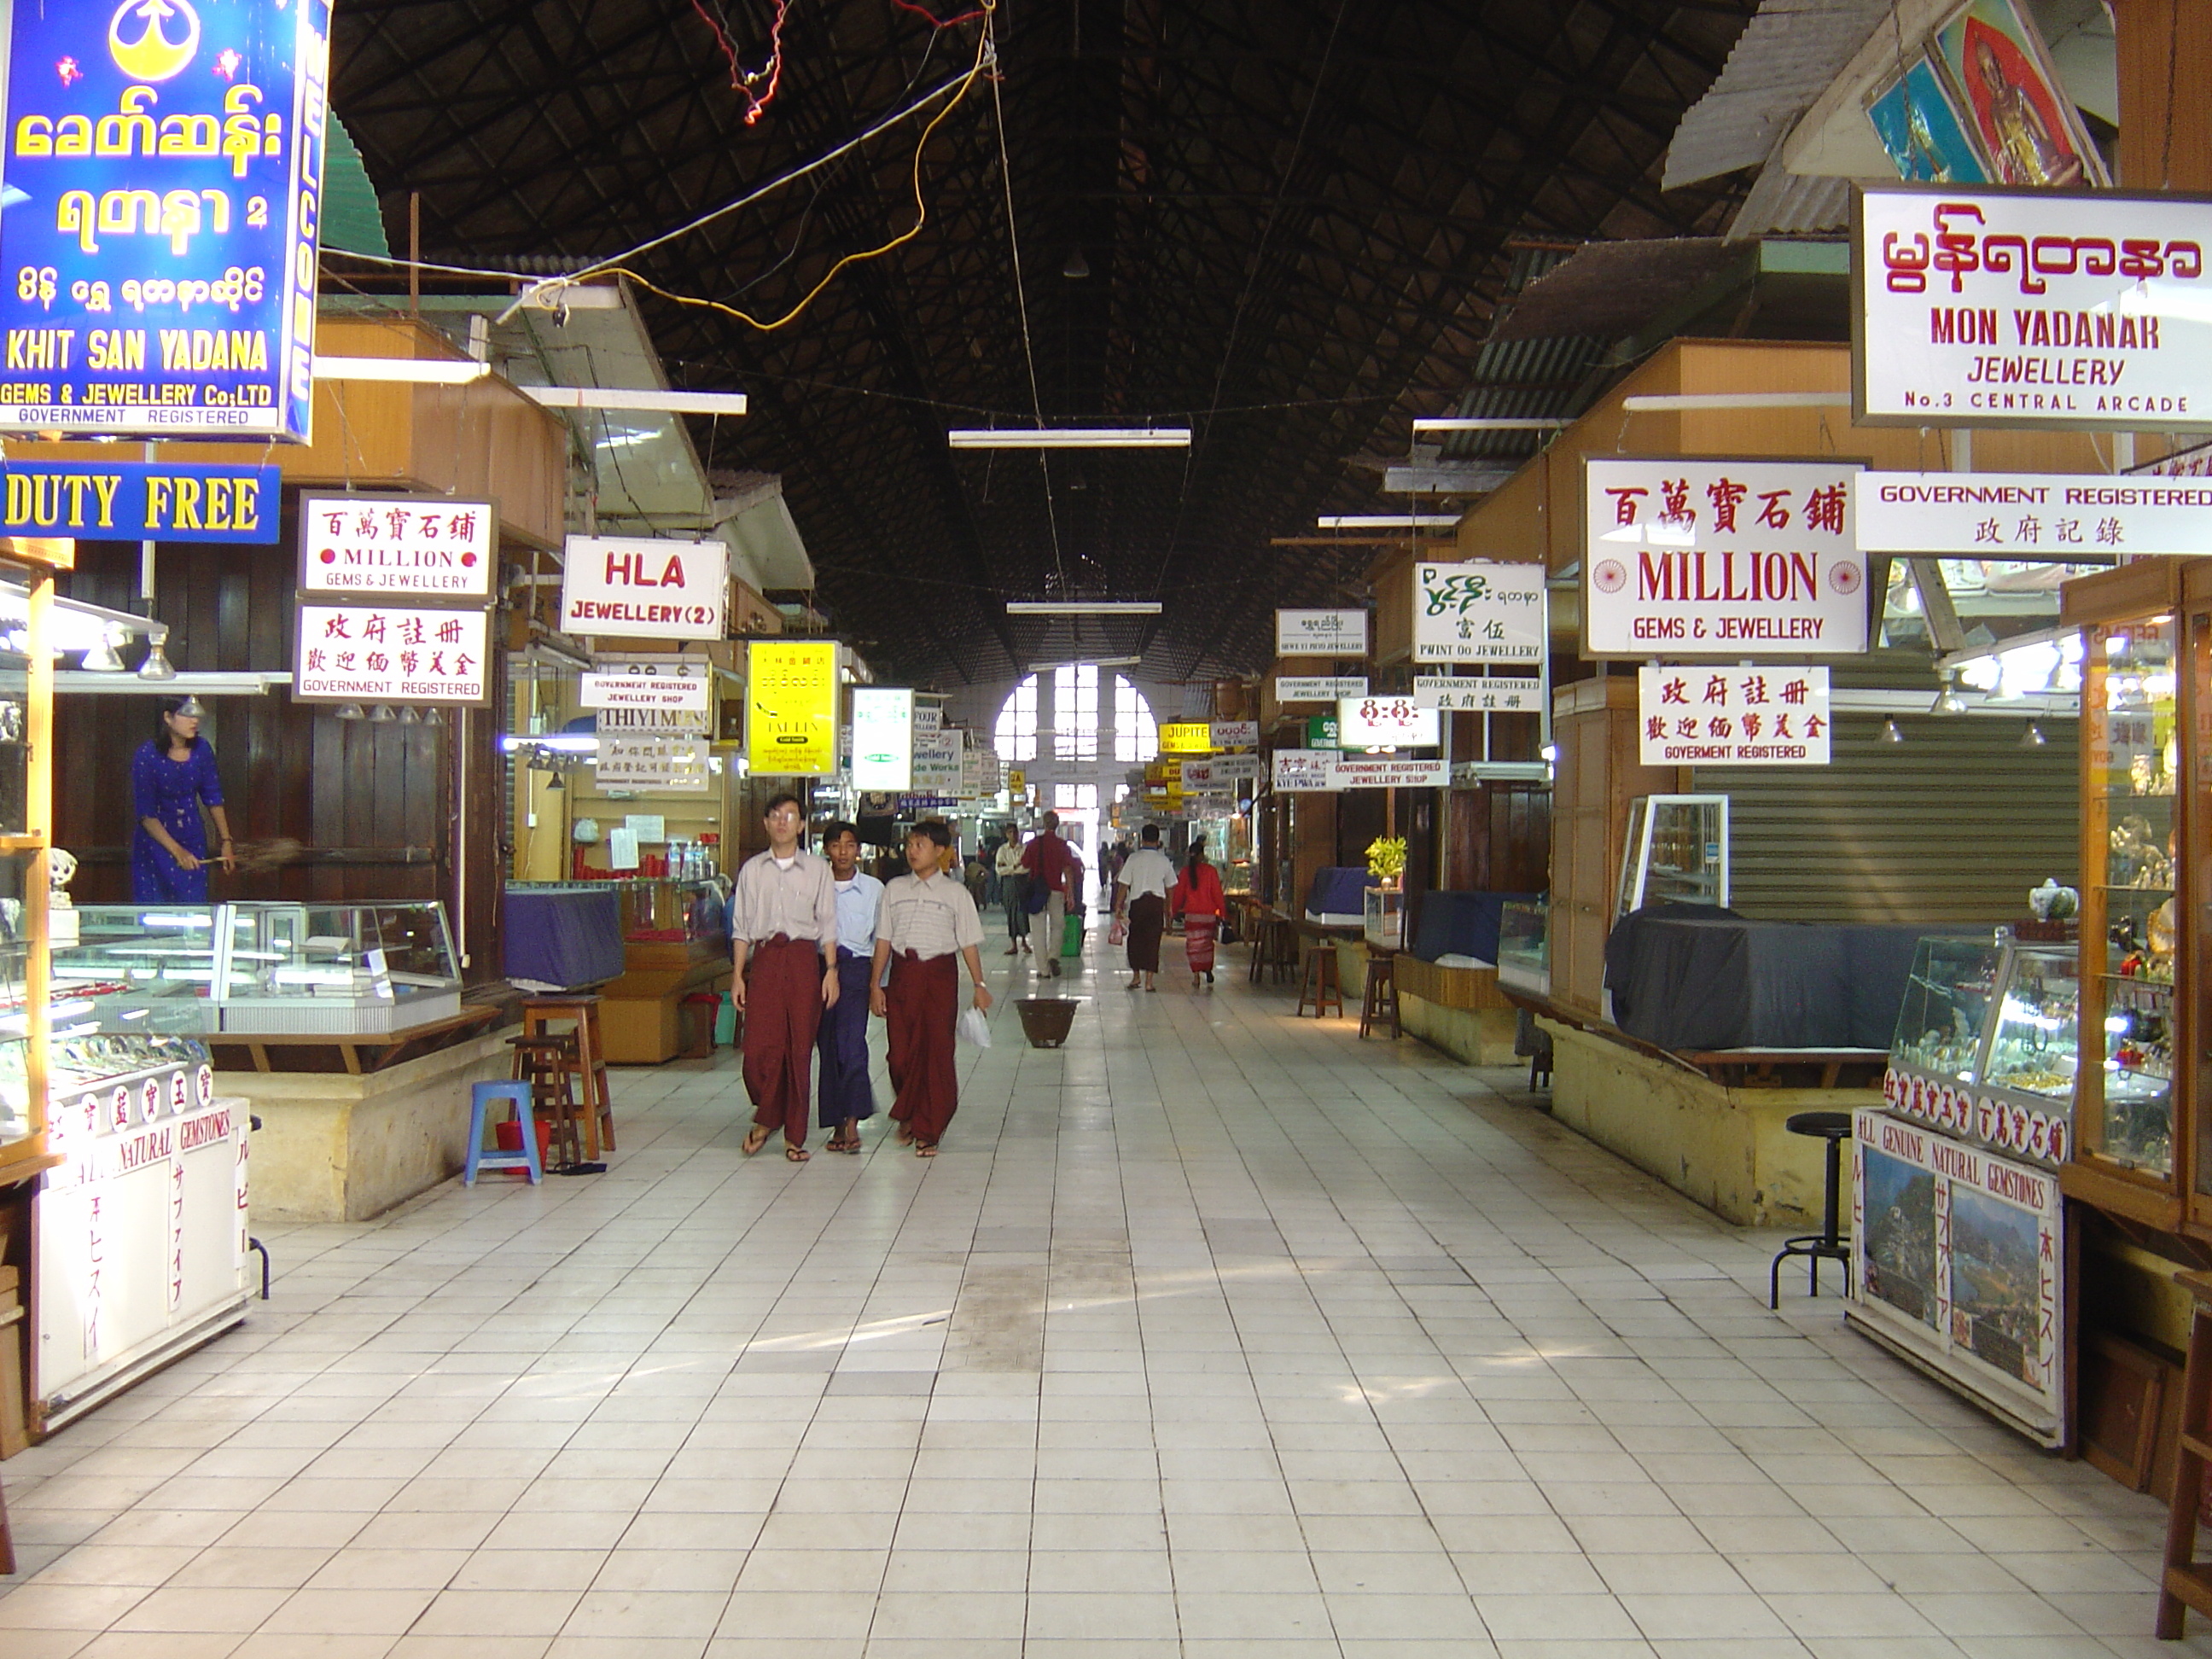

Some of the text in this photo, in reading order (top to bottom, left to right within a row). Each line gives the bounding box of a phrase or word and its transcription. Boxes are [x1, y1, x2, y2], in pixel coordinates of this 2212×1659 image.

[290, 22, 328, 403] WELCOME
[1930, 307, 1999, 346] MON
[7, 329, 268, 371] KHIT SAN YADANA
[1967, 355, 2126, 386] JEWELLERY
[0, 384, 52, 405] GEMS
[61, 384, 73, 405] &
[82, 384, 196, 406] JEWELLERY
[1904, 390, 2188, 413] No.3 CENTRAL ARCADE
[18, 409, 249, 425] GOVERNMENT REGISTERED
[3, 474, 259, 530] DUTY FREE
[1880, 485, 2212, 507] GOVERNMENT REGISTERED
[1974, 514, 2125, 547] 政府記錄
[343, 548, 454, 568] MILLION
[604, 550, 685, 588] HLA
[326, 573, 469, 589] GEMS & JEWELLERY
[1637, 550, 1819, 602] MILLION
[1633, 617, 1825, 639] GEMS & JEWELLERY
[1419, 644, 1452, 656] PWINT
[1476, 645, 1540, 657] JEWELLERY
[303, 679, 480, 696] GOVERNMENT REGISTERED
[594, 680, 697, 690] GOVERNMENT REGISTERED
[1417, 678, 1540, 690] GOVERNMENT REGISTERED
[607, 694, 684, 703] JEWELLERY SHOP
[1664, 745, 1807, 760] GOVERMENT REGISTERED
[1335, 764, 1388, 773] GOVERNMENT
[1391, 762, 1441, 772] REGISTERED
[1349, 775, 1428, 784] JEWELLERY SHOP
[118, 1126, 172, 1172] NATURAL
[180, 1109, 230, 1150] GEMSTONES
[1857, 1114, 2045, 1210] ALL GENUINE NATURAL GEMSTONES
